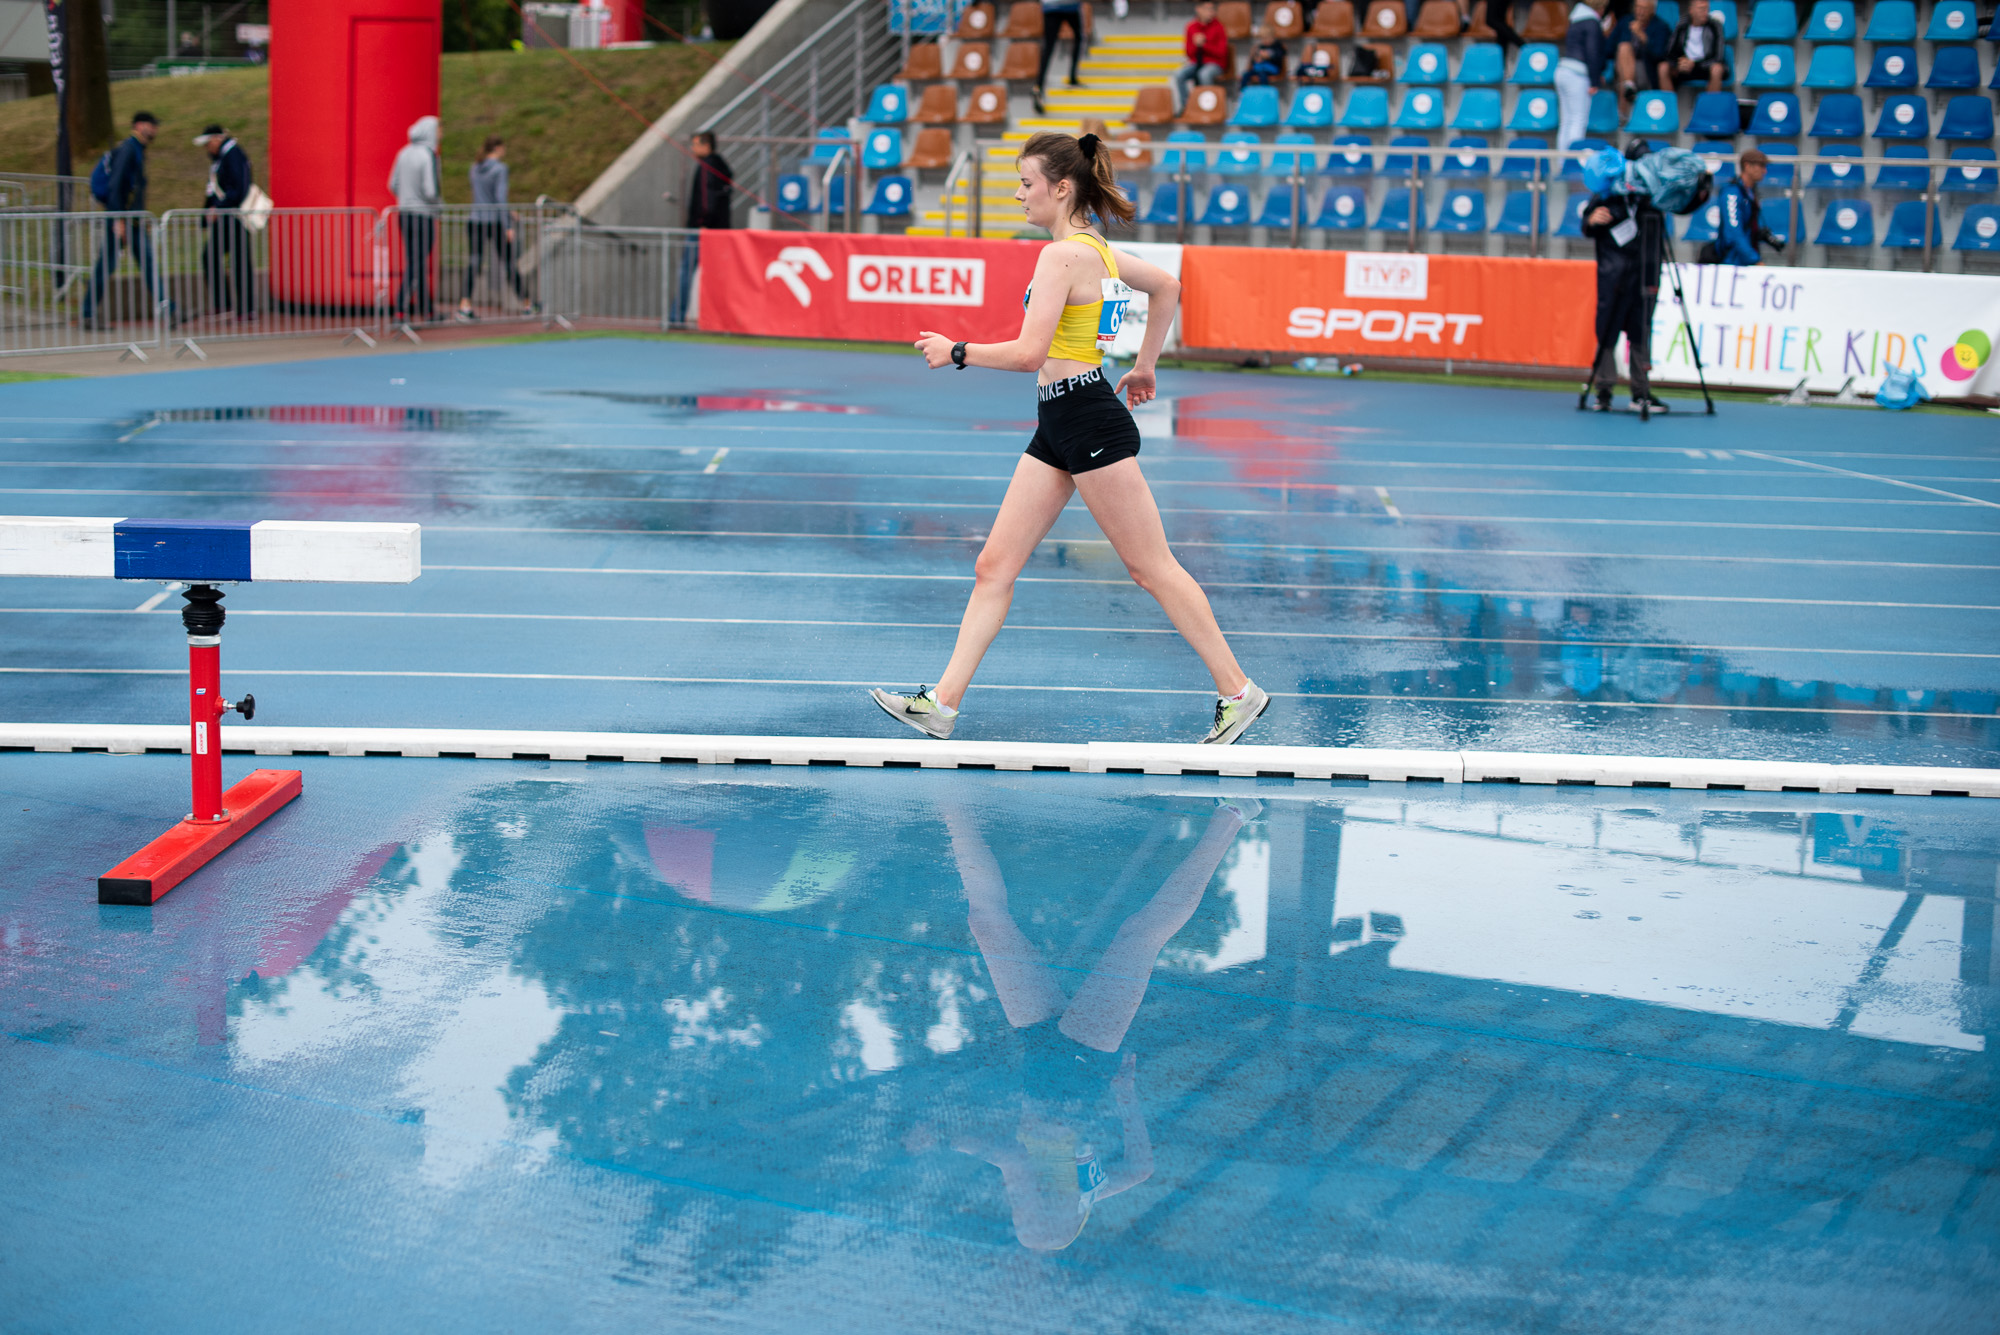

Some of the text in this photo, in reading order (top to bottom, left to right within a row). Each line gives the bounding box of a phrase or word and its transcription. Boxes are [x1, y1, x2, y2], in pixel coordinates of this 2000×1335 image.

[859, 264, 973, 296] ORLEN
[1361, 266, 1412, 284] TVP
[1761, 274, 1804, 311] for
[1286, 307, 1483, 345] SPORT
[1843, 329, 1928, 379] KIDS
[1038, 368, 1101, 402] NIKE PRO
